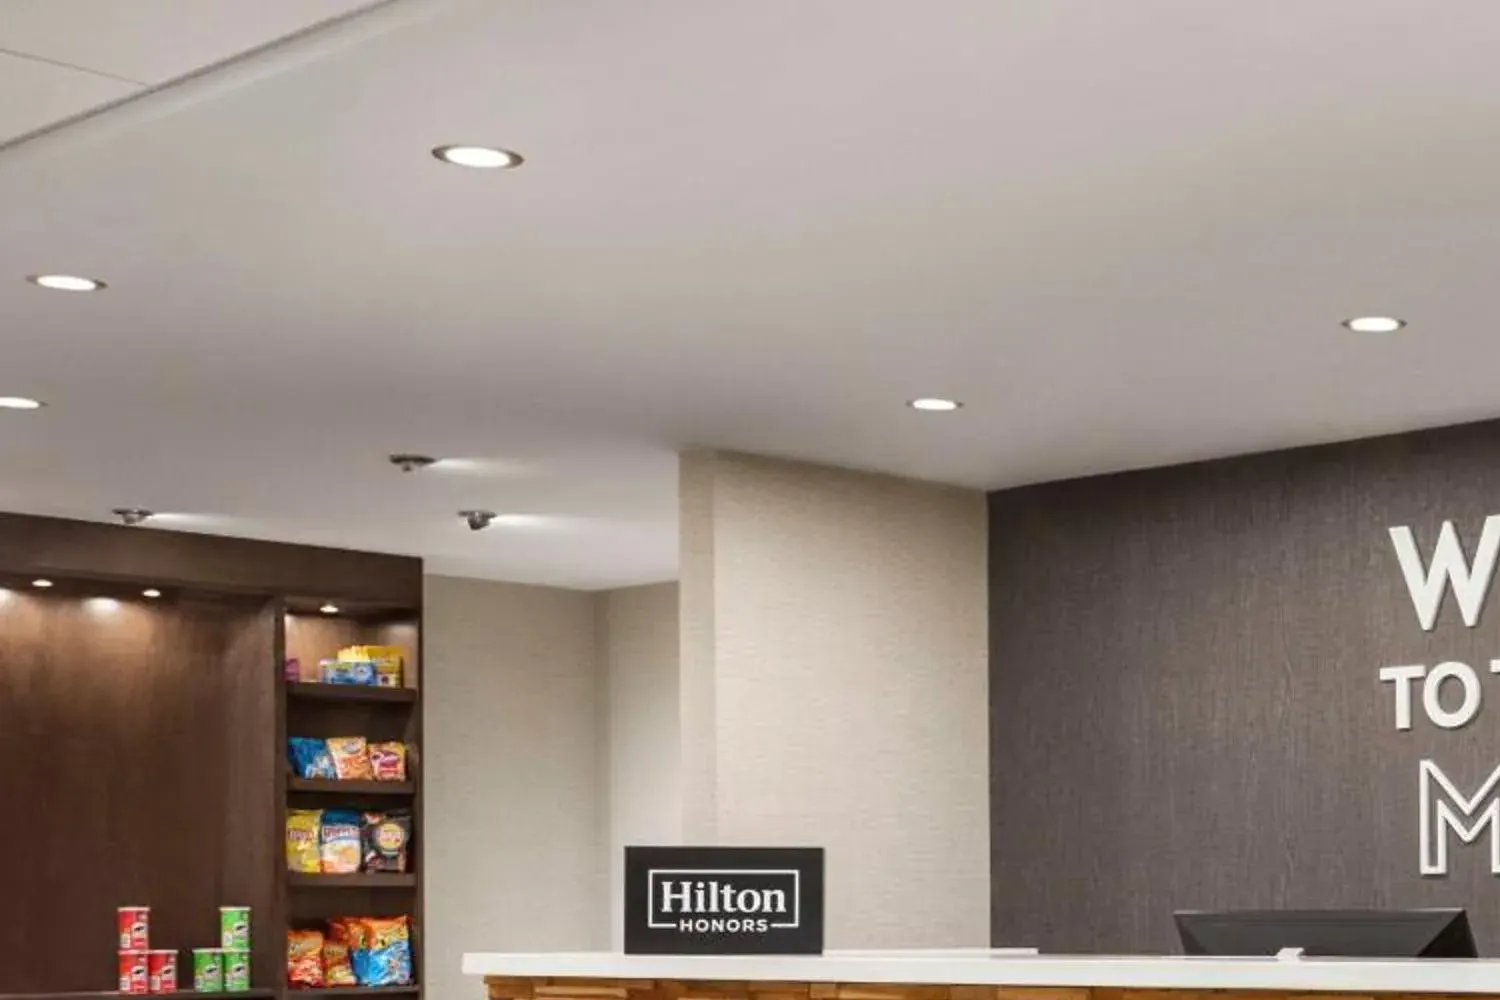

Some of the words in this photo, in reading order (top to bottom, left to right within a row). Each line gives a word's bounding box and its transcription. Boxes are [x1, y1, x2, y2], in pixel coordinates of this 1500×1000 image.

[1379, 661, 1482, 730] TO
[660, 880, 787, 913] Hilton
[679, 918, 769, 932] HONORS
